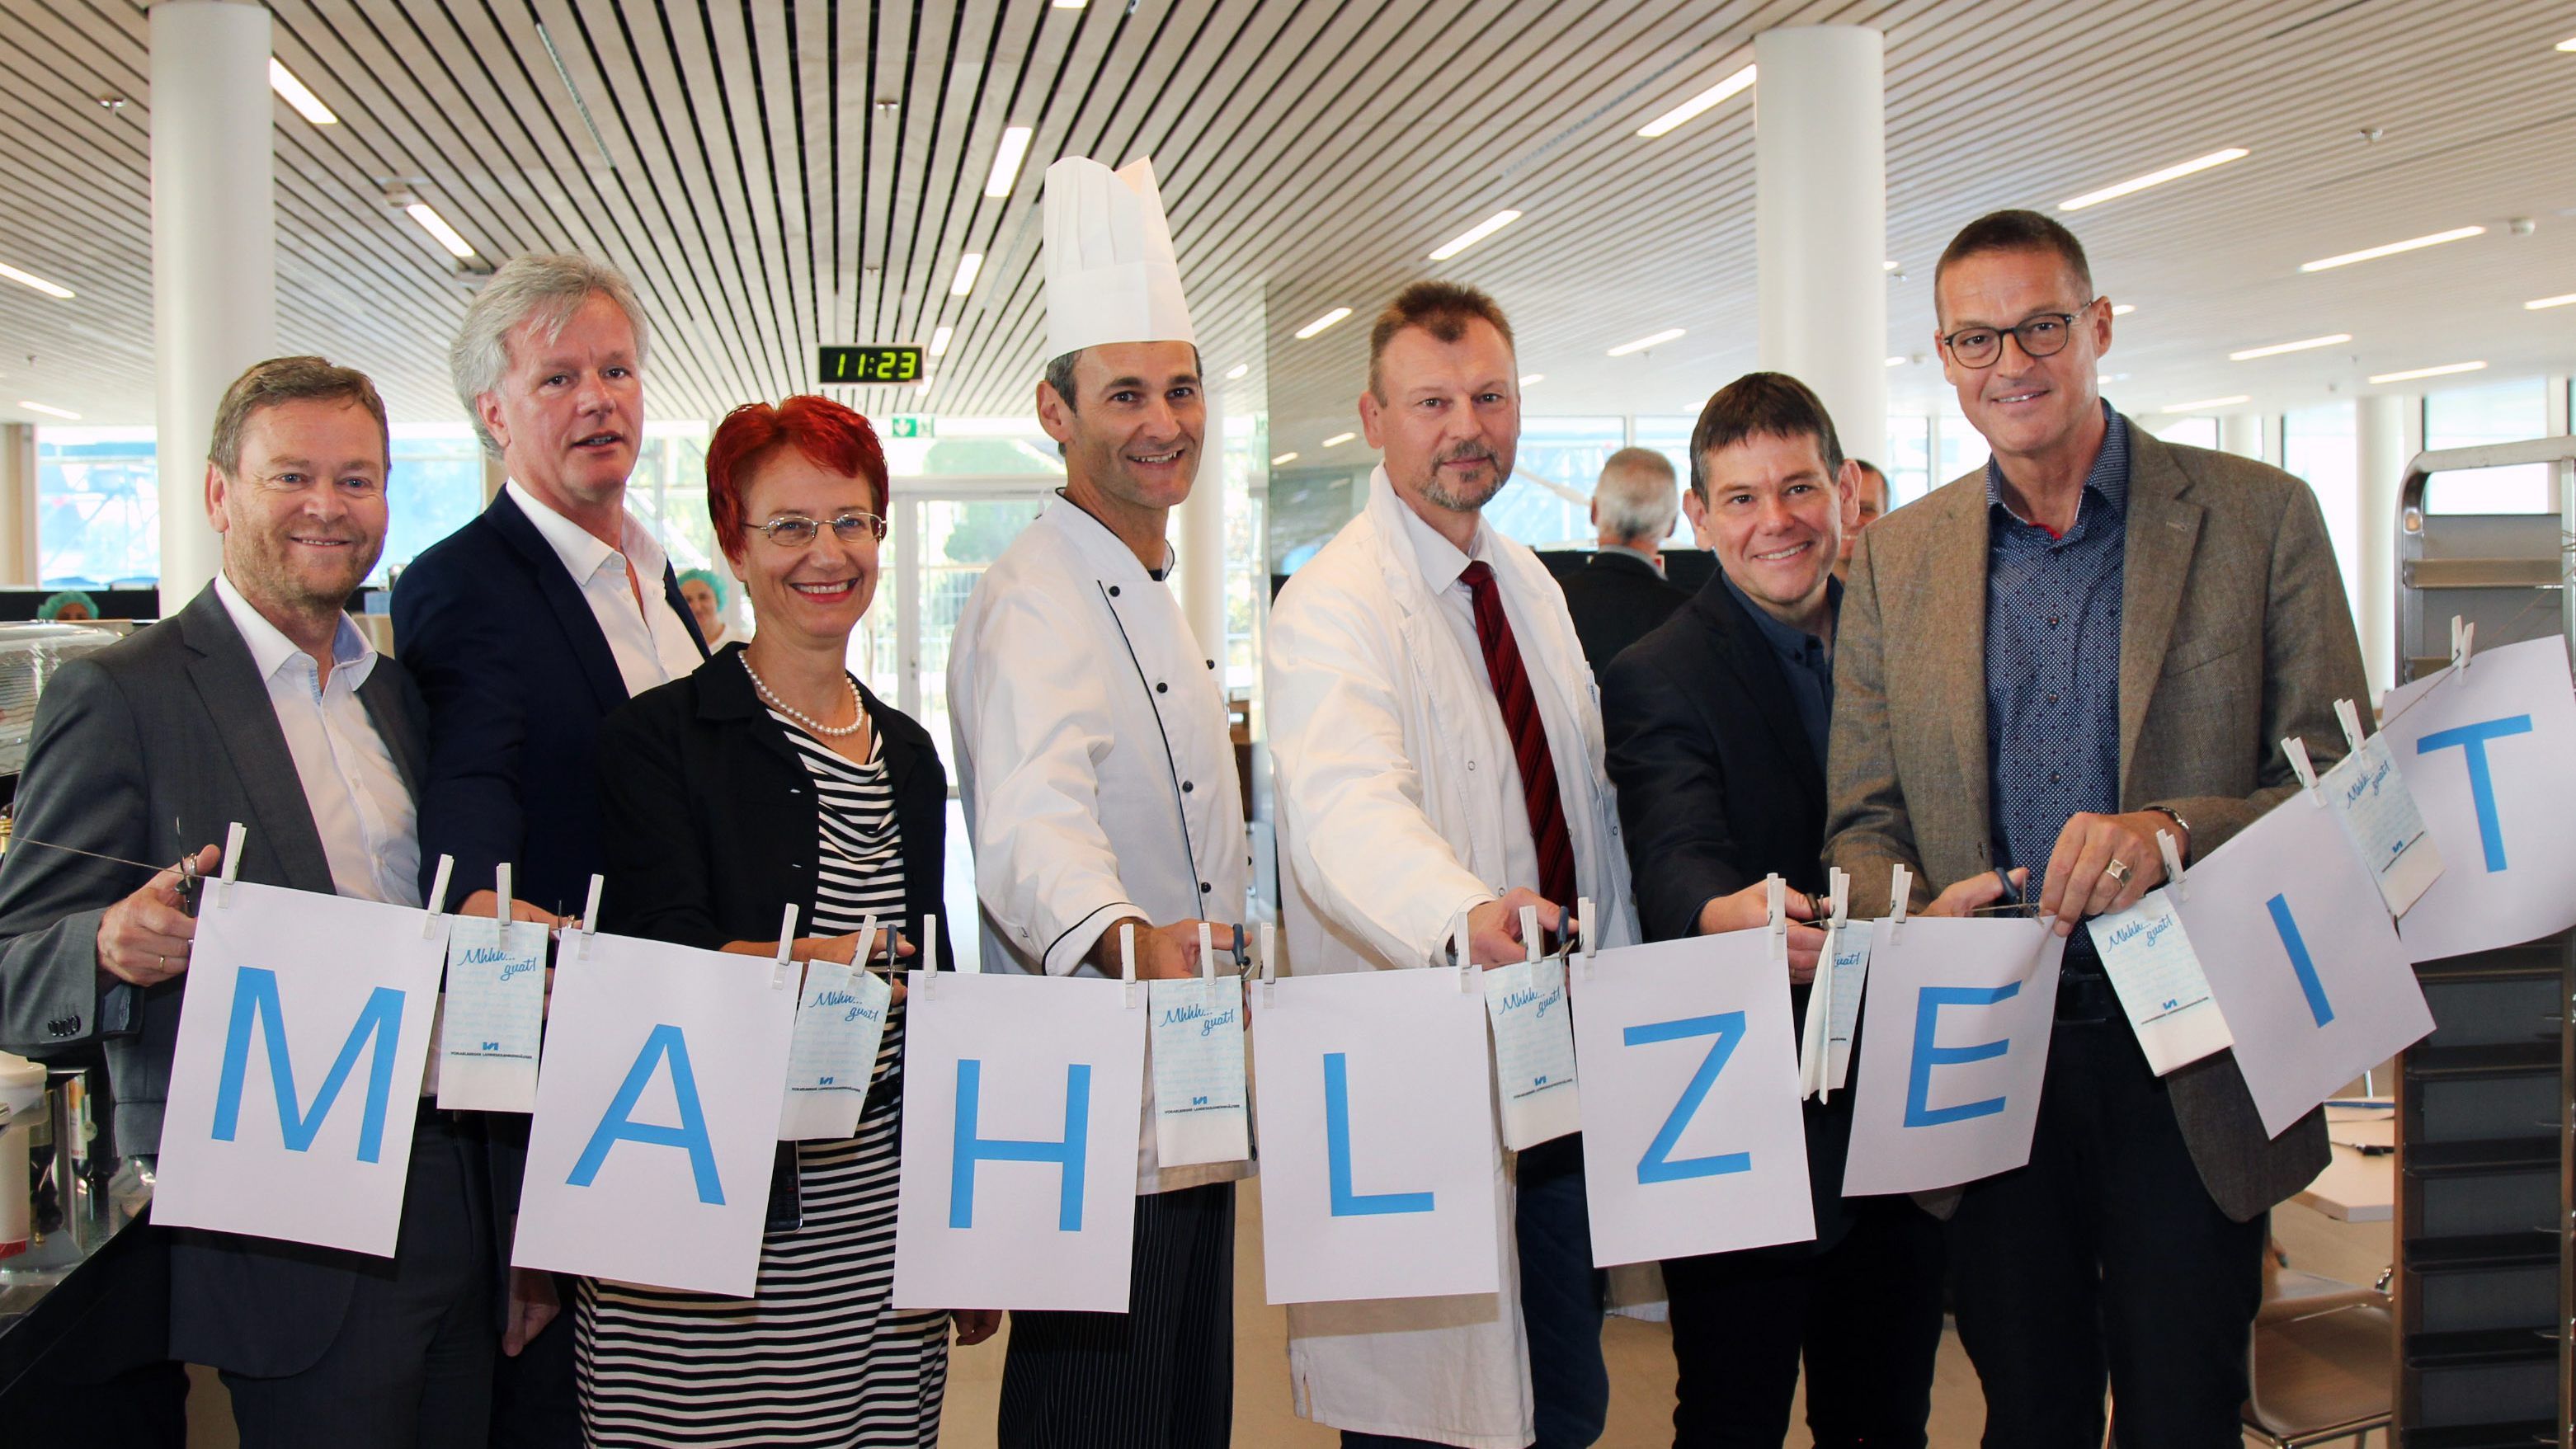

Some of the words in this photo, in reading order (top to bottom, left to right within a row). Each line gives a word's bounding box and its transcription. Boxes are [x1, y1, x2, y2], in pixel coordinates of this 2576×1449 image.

[837, 352, 916, 379] 11:23
[2417, 713, 2534, 873] T
[500, 957, 536, 981] guat!
[1201, 1009, 1235, 1037] guat!
[1537, 986, 1561, 1019] guat!
[2268, 895, 2334, 1027] I
[210, 966, 406, 1164] M
[567, 1024, 726, 1206] A
[1624, 1010, 1752, 1185] Z
[1905, 985, 2017, 1127] E
[949, 1059, 1092, 1232] H
[1324, 1052, 1435, 1217] L
